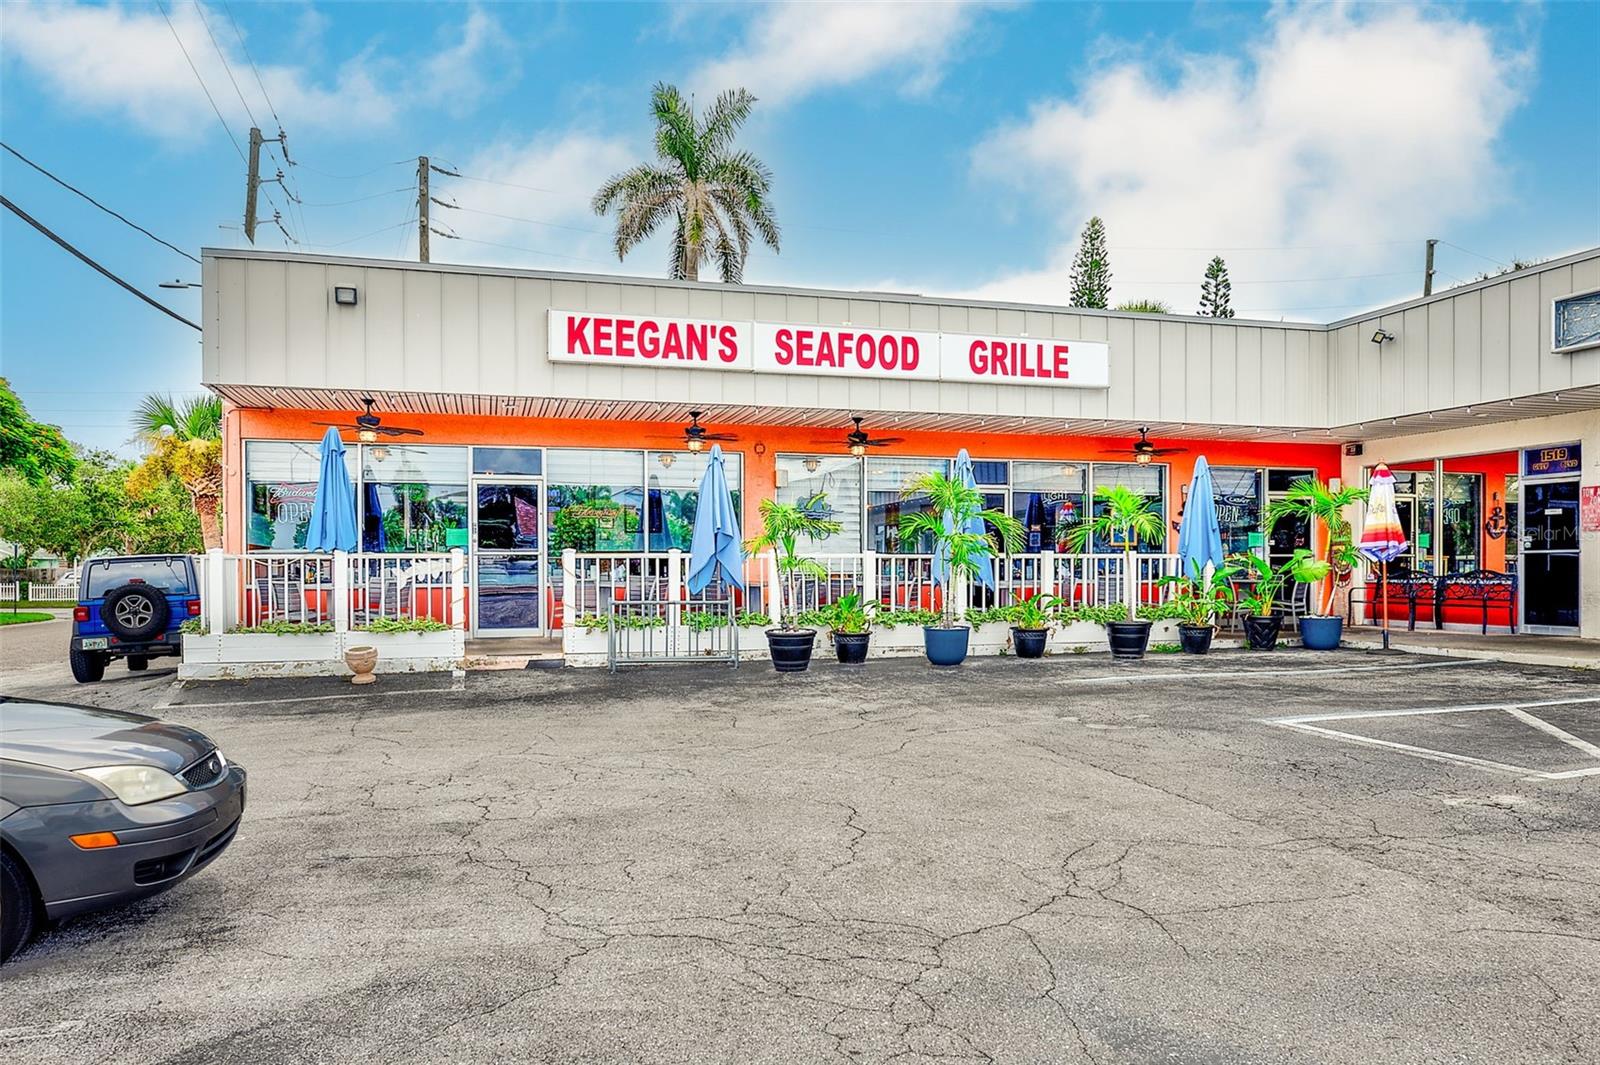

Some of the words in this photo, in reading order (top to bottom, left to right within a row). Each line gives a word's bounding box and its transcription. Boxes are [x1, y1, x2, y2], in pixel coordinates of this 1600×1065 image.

[567, 316, 738, 362] KEEGAN'S
[775, 328, 920, 371] SEAFOOD
[969, 340, 1069, 379] GRILLE
[1541, 448, 1567, 461] 1519
